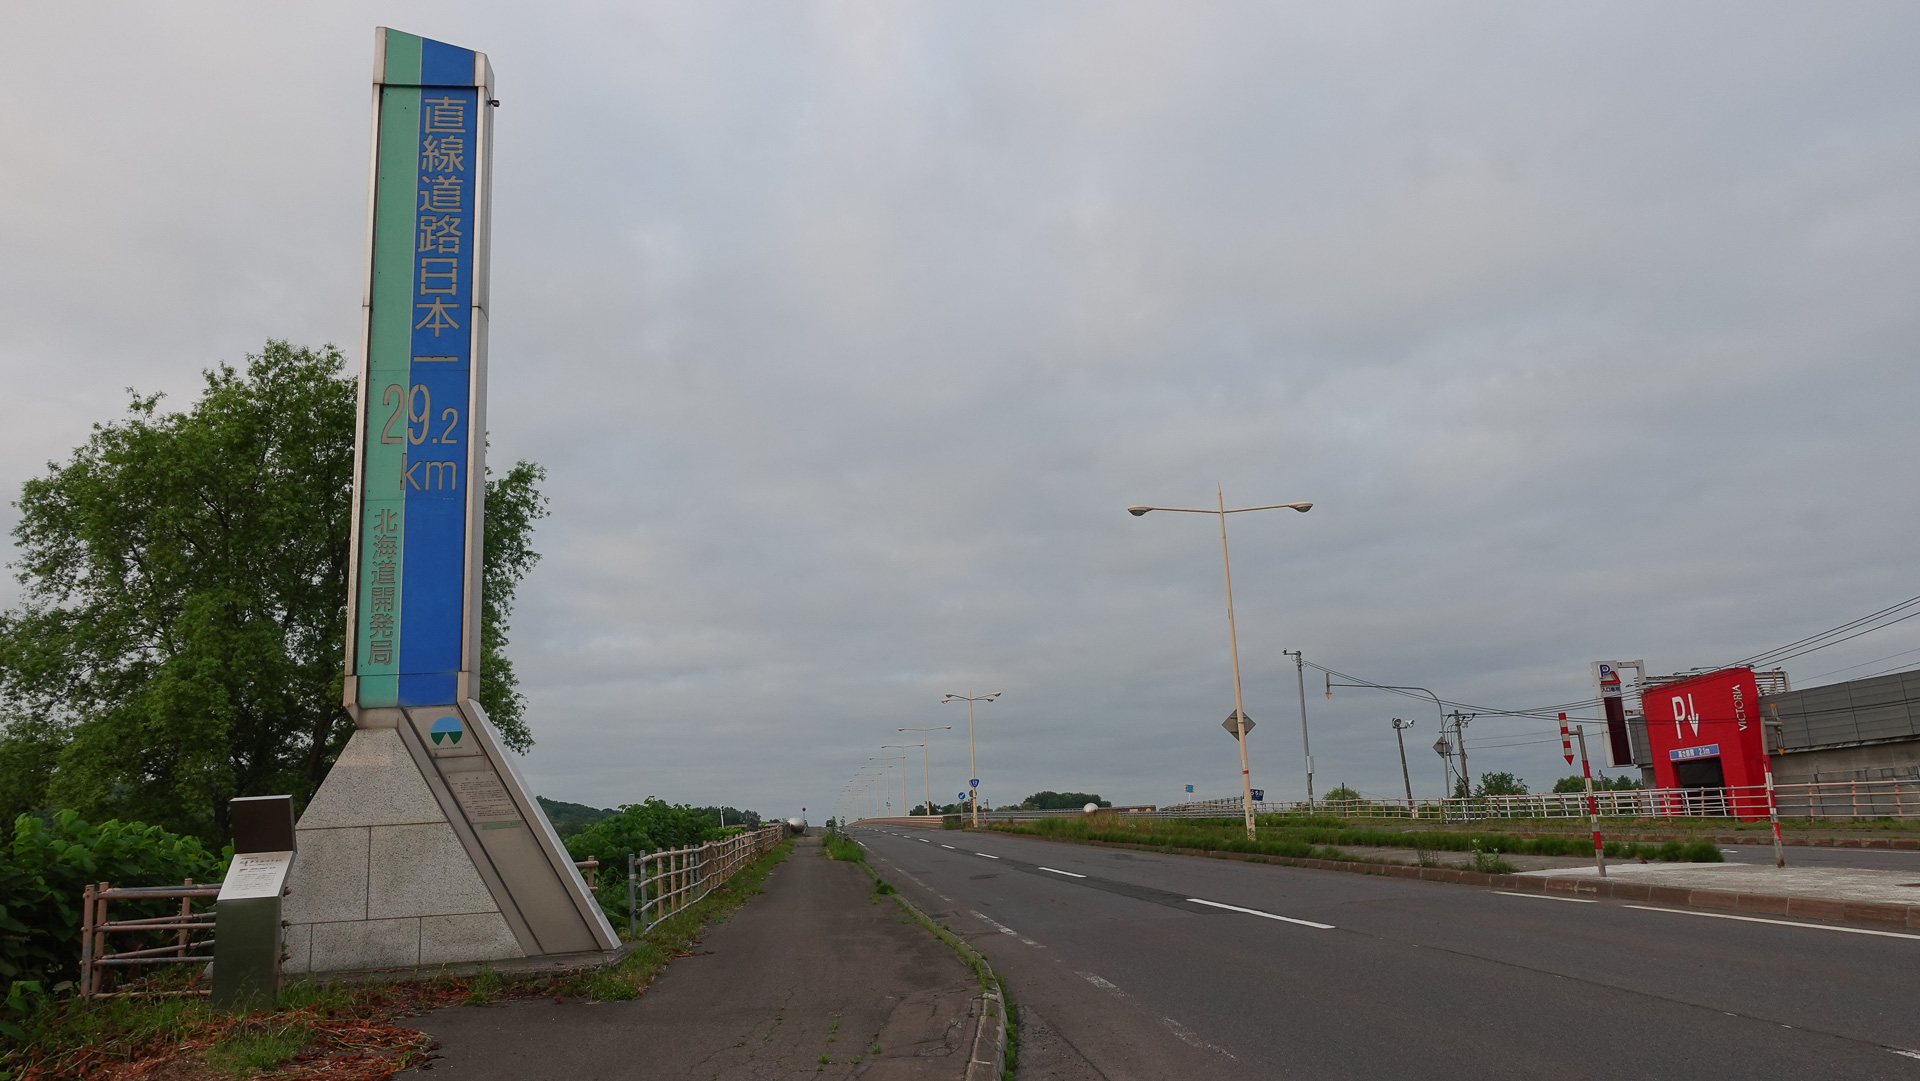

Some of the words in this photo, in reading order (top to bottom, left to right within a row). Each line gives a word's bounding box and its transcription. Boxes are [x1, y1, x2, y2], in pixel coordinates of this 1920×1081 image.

[414, 96, 467, 362] 直線道路日本一
[381, 384, 459, 446] 29.2
[400, 453, 456, 490] km
[368, 508, 398, 666] 北海道開発局
[1671, 696, 1686, 740] P
[1732, 684, 1748, 731] VICTORIA
